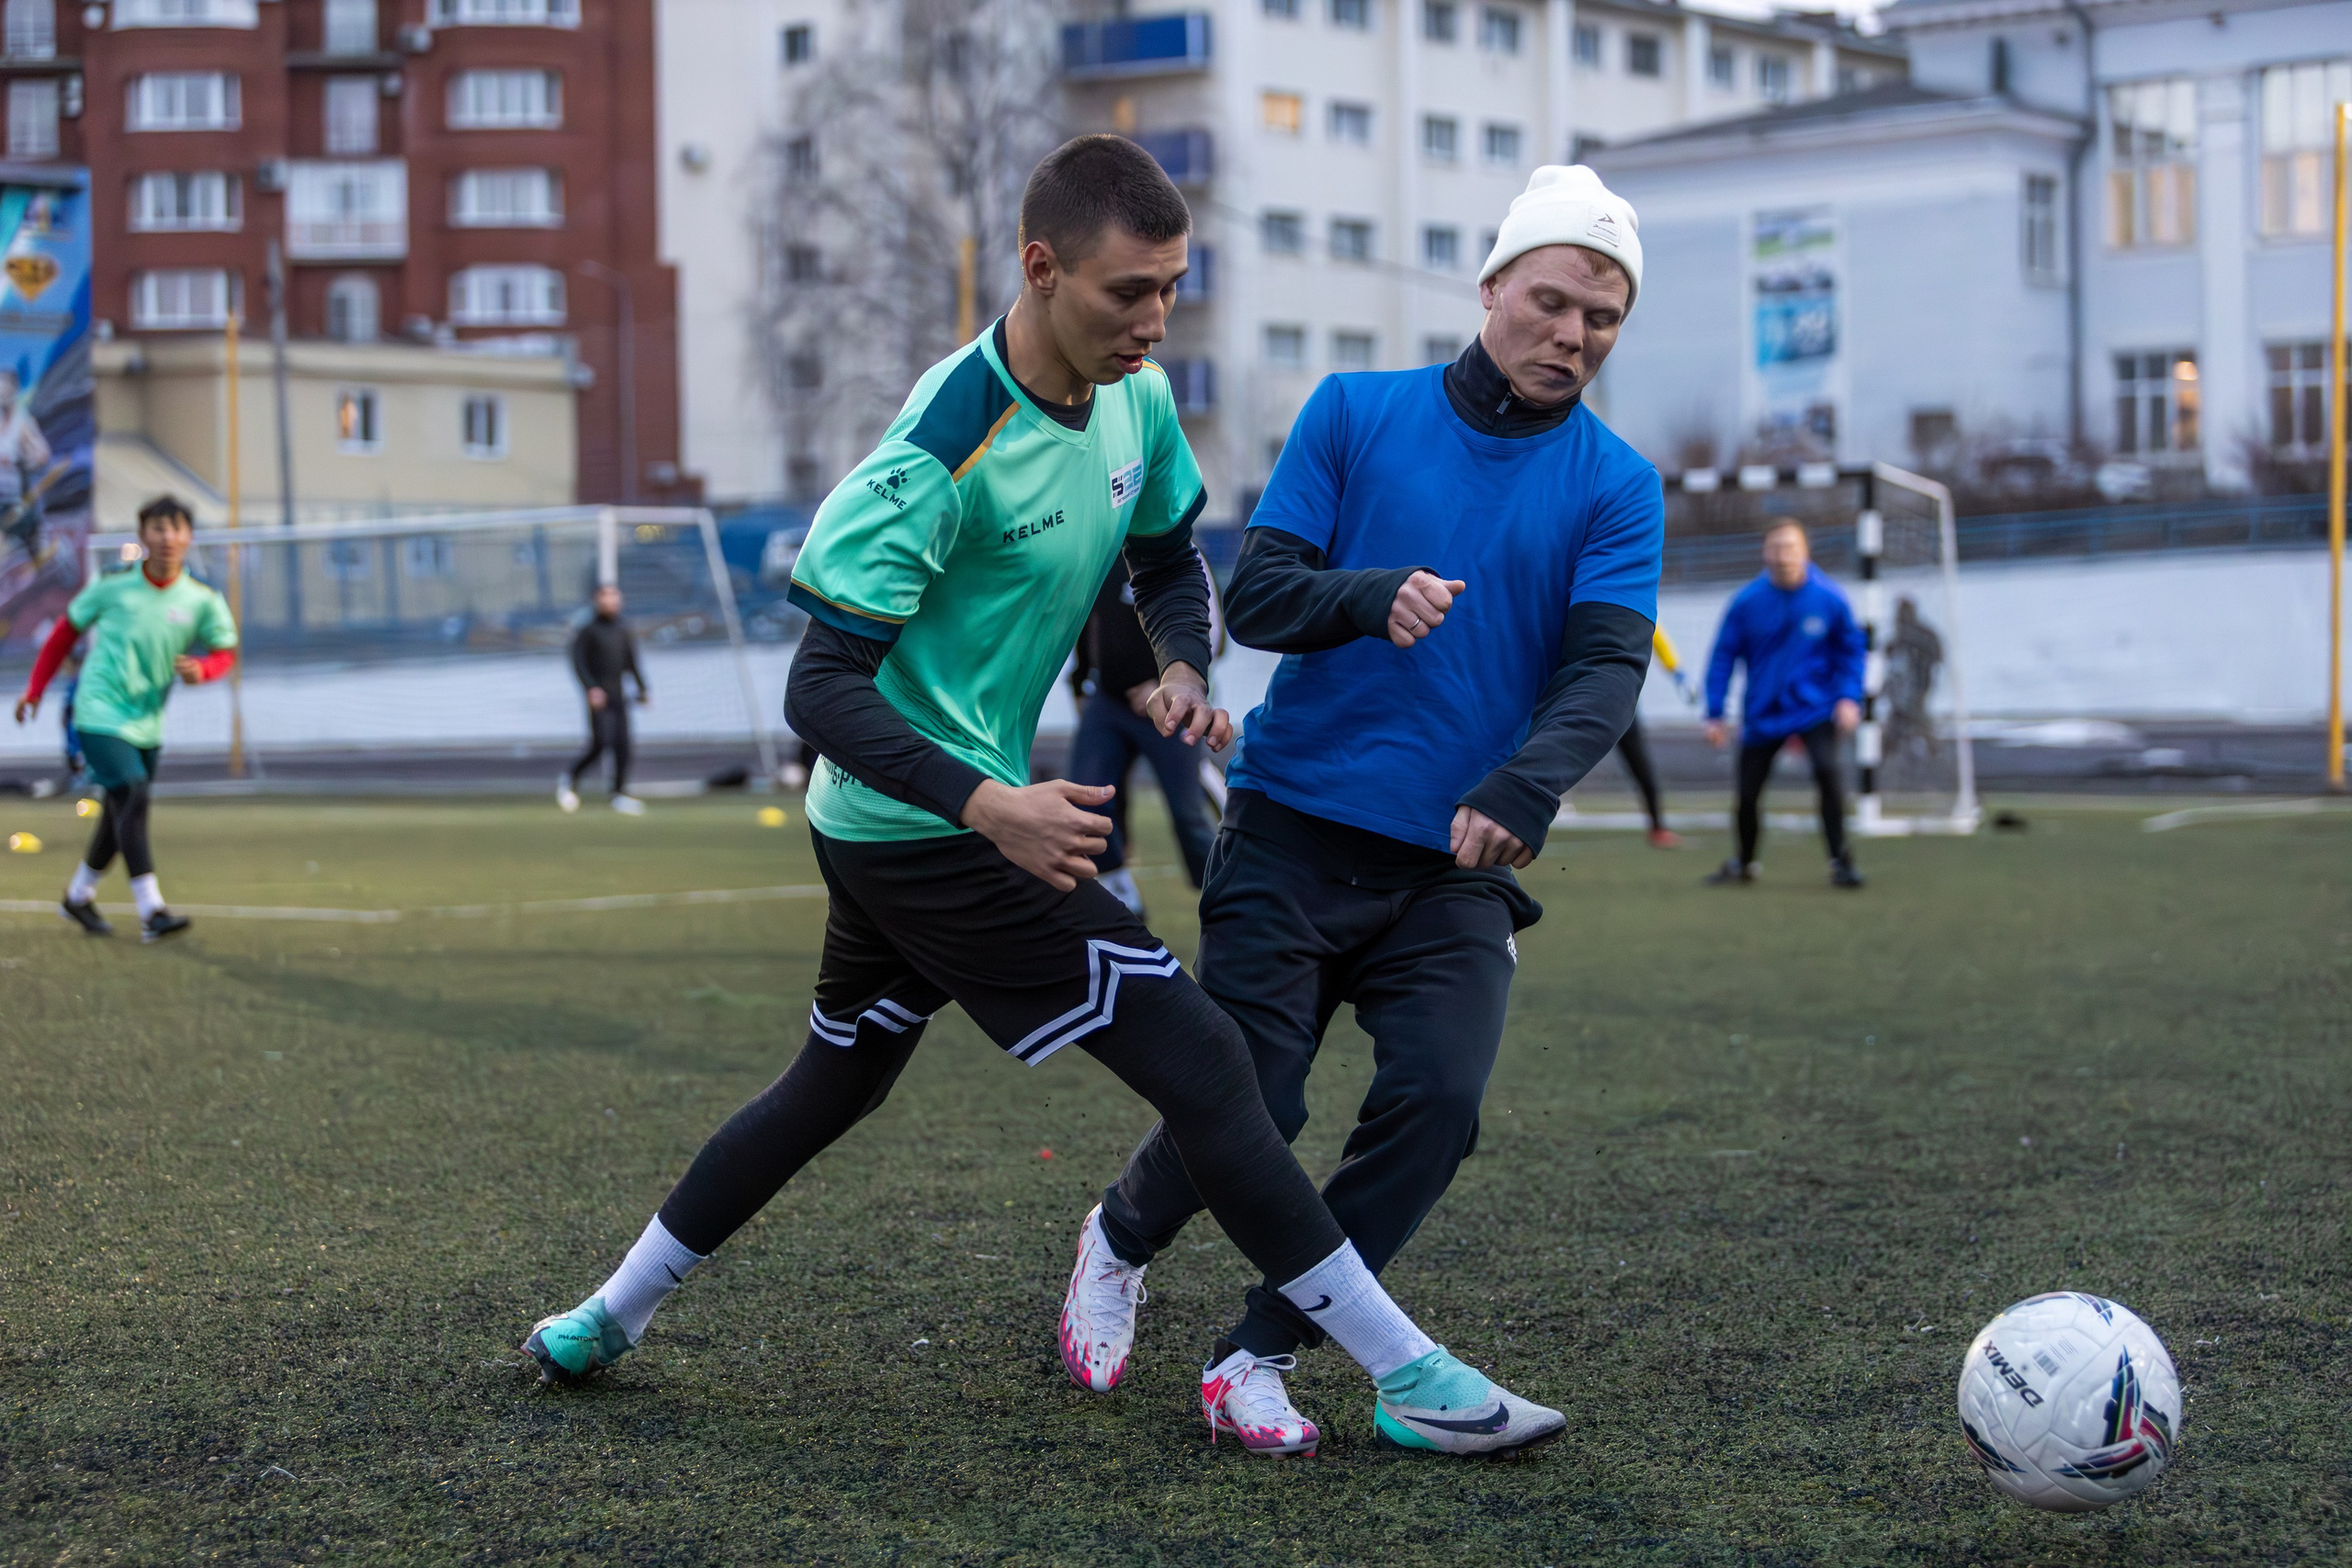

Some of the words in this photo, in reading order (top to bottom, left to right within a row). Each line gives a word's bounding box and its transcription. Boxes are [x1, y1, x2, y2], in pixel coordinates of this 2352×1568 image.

[865, 479, 907, 511] KELME
[1002, 509, 1065, 544] KELME
[1982, 1339, 2045, 1408] DEMIX
